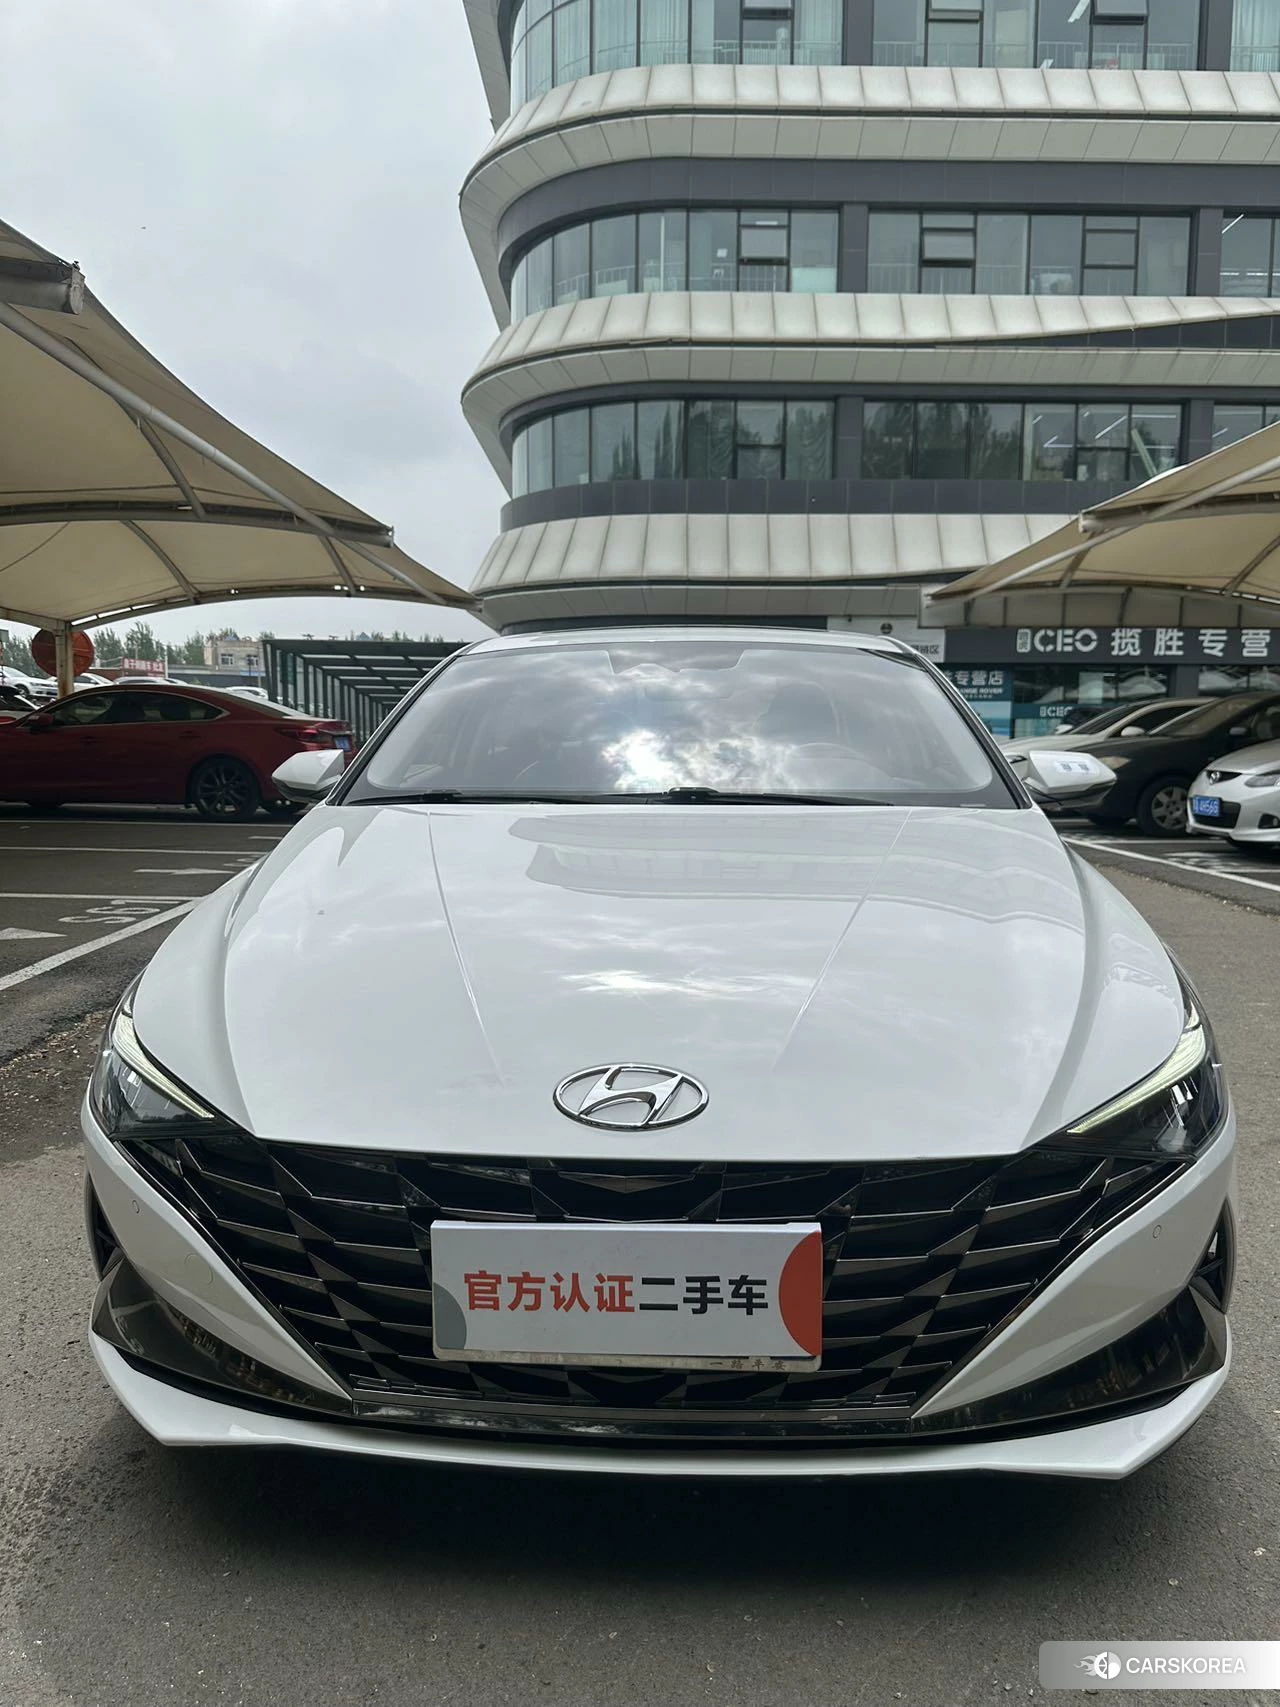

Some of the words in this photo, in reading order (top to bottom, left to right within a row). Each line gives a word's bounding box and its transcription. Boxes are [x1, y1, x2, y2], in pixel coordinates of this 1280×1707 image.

[1033, 628, 1098, 653] CEO
[1110, 627, 1271, 657] 揽胜专营
[463, 1270, 769, 1316] 官方认证二手车
